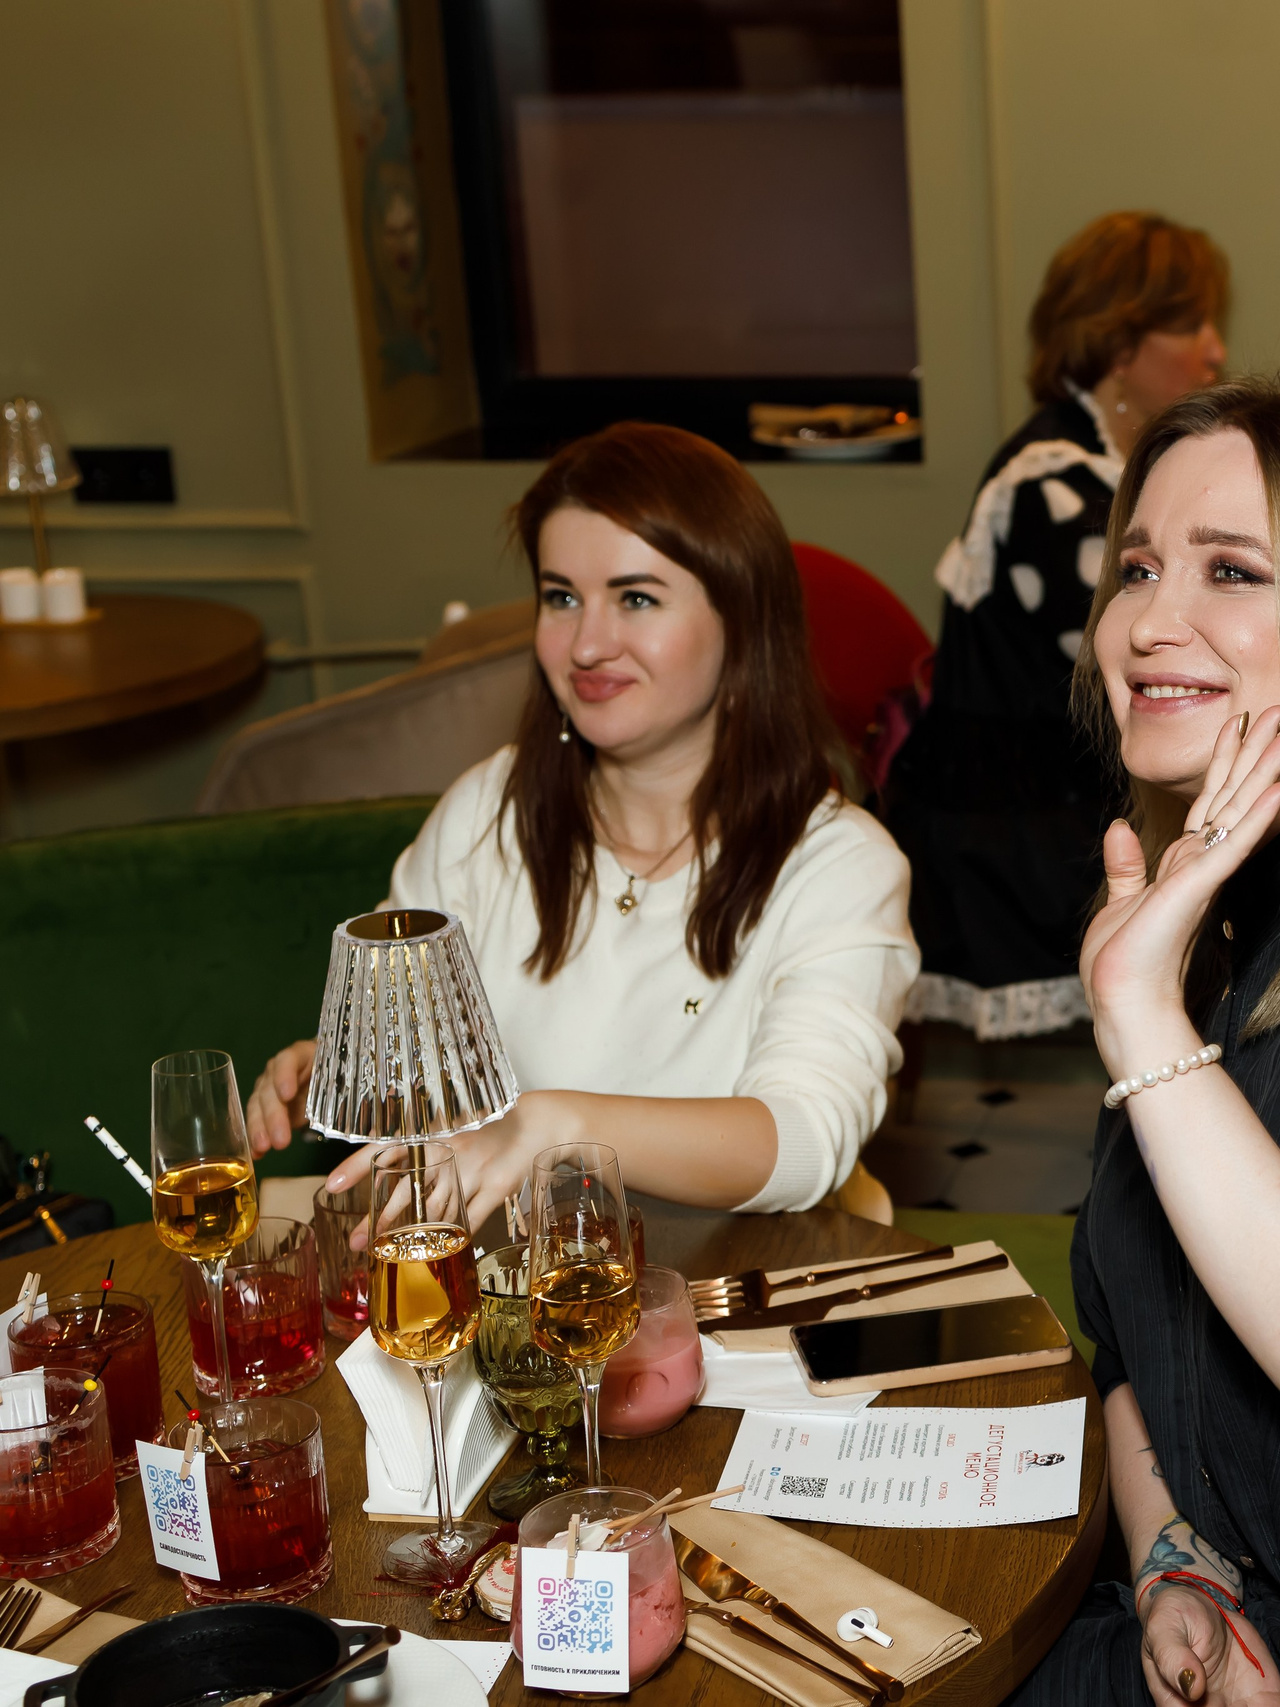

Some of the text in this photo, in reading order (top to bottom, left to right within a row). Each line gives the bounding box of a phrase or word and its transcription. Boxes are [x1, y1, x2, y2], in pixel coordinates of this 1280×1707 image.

[963, 1452, 982, 1479] МЕНЮ
[979, 1424, 1004, 1508] ДЕГУСТАЦИОННОЕ
[159, 1542, 207, 1562] САМОДОСТАТОЧНОСТЬ
[531, 1664, 565, 1674] ГОТОВНОСТЬ
[572, 1668, 620, 1676] ПРИКЛЮЧЕНИЯМ
